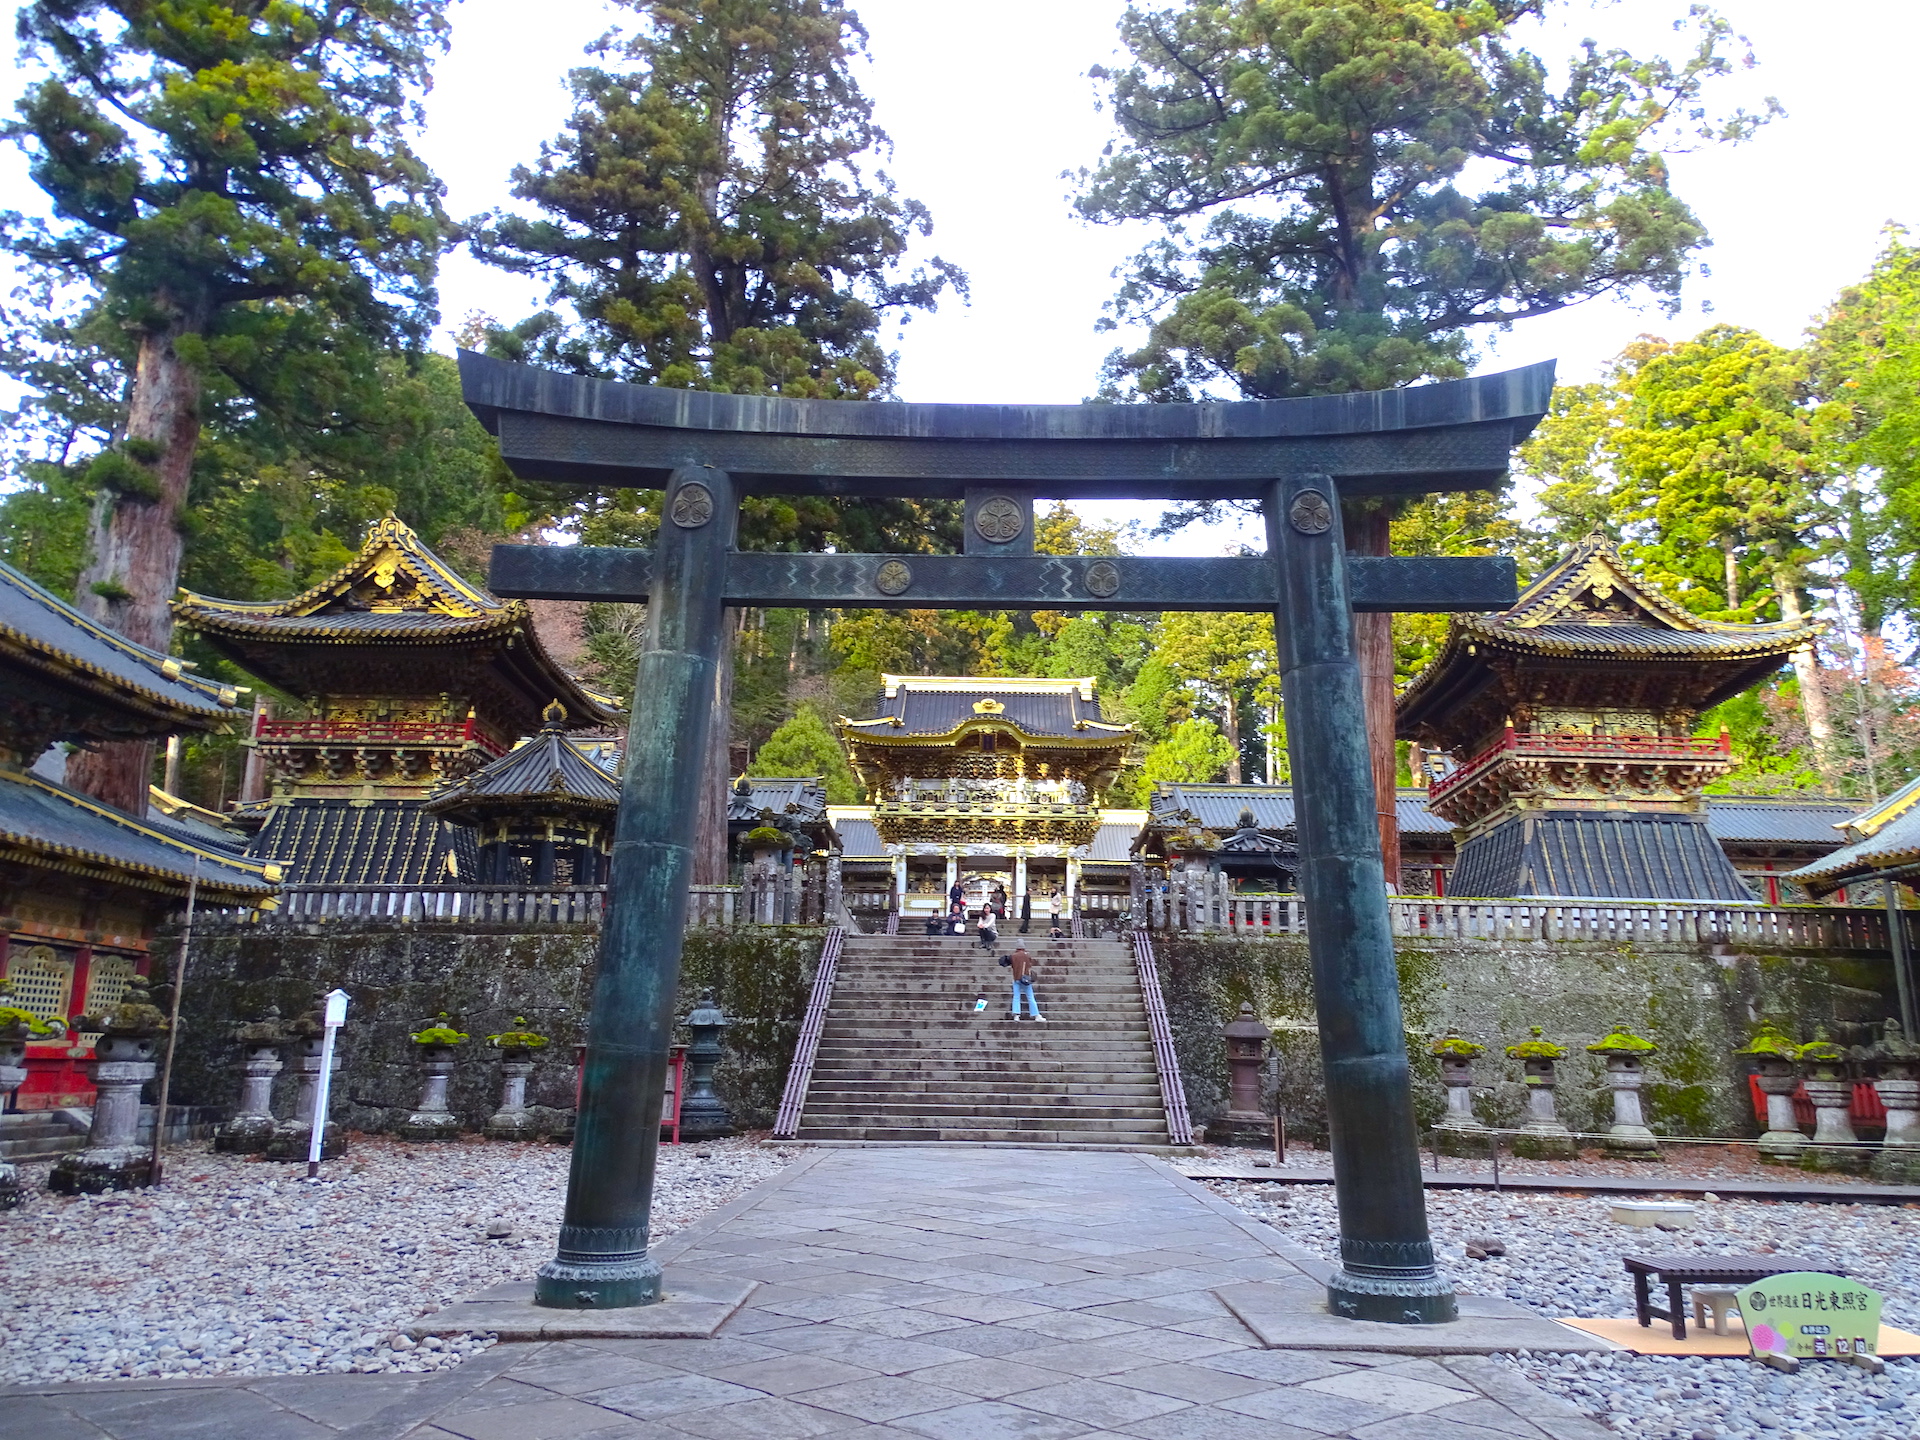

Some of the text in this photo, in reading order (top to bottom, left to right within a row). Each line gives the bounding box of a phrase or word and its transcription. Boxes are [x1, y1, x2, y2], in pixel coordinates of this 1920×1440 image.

[1768, 1290, 1868, 1311] 世界遺産 日光東照宮
